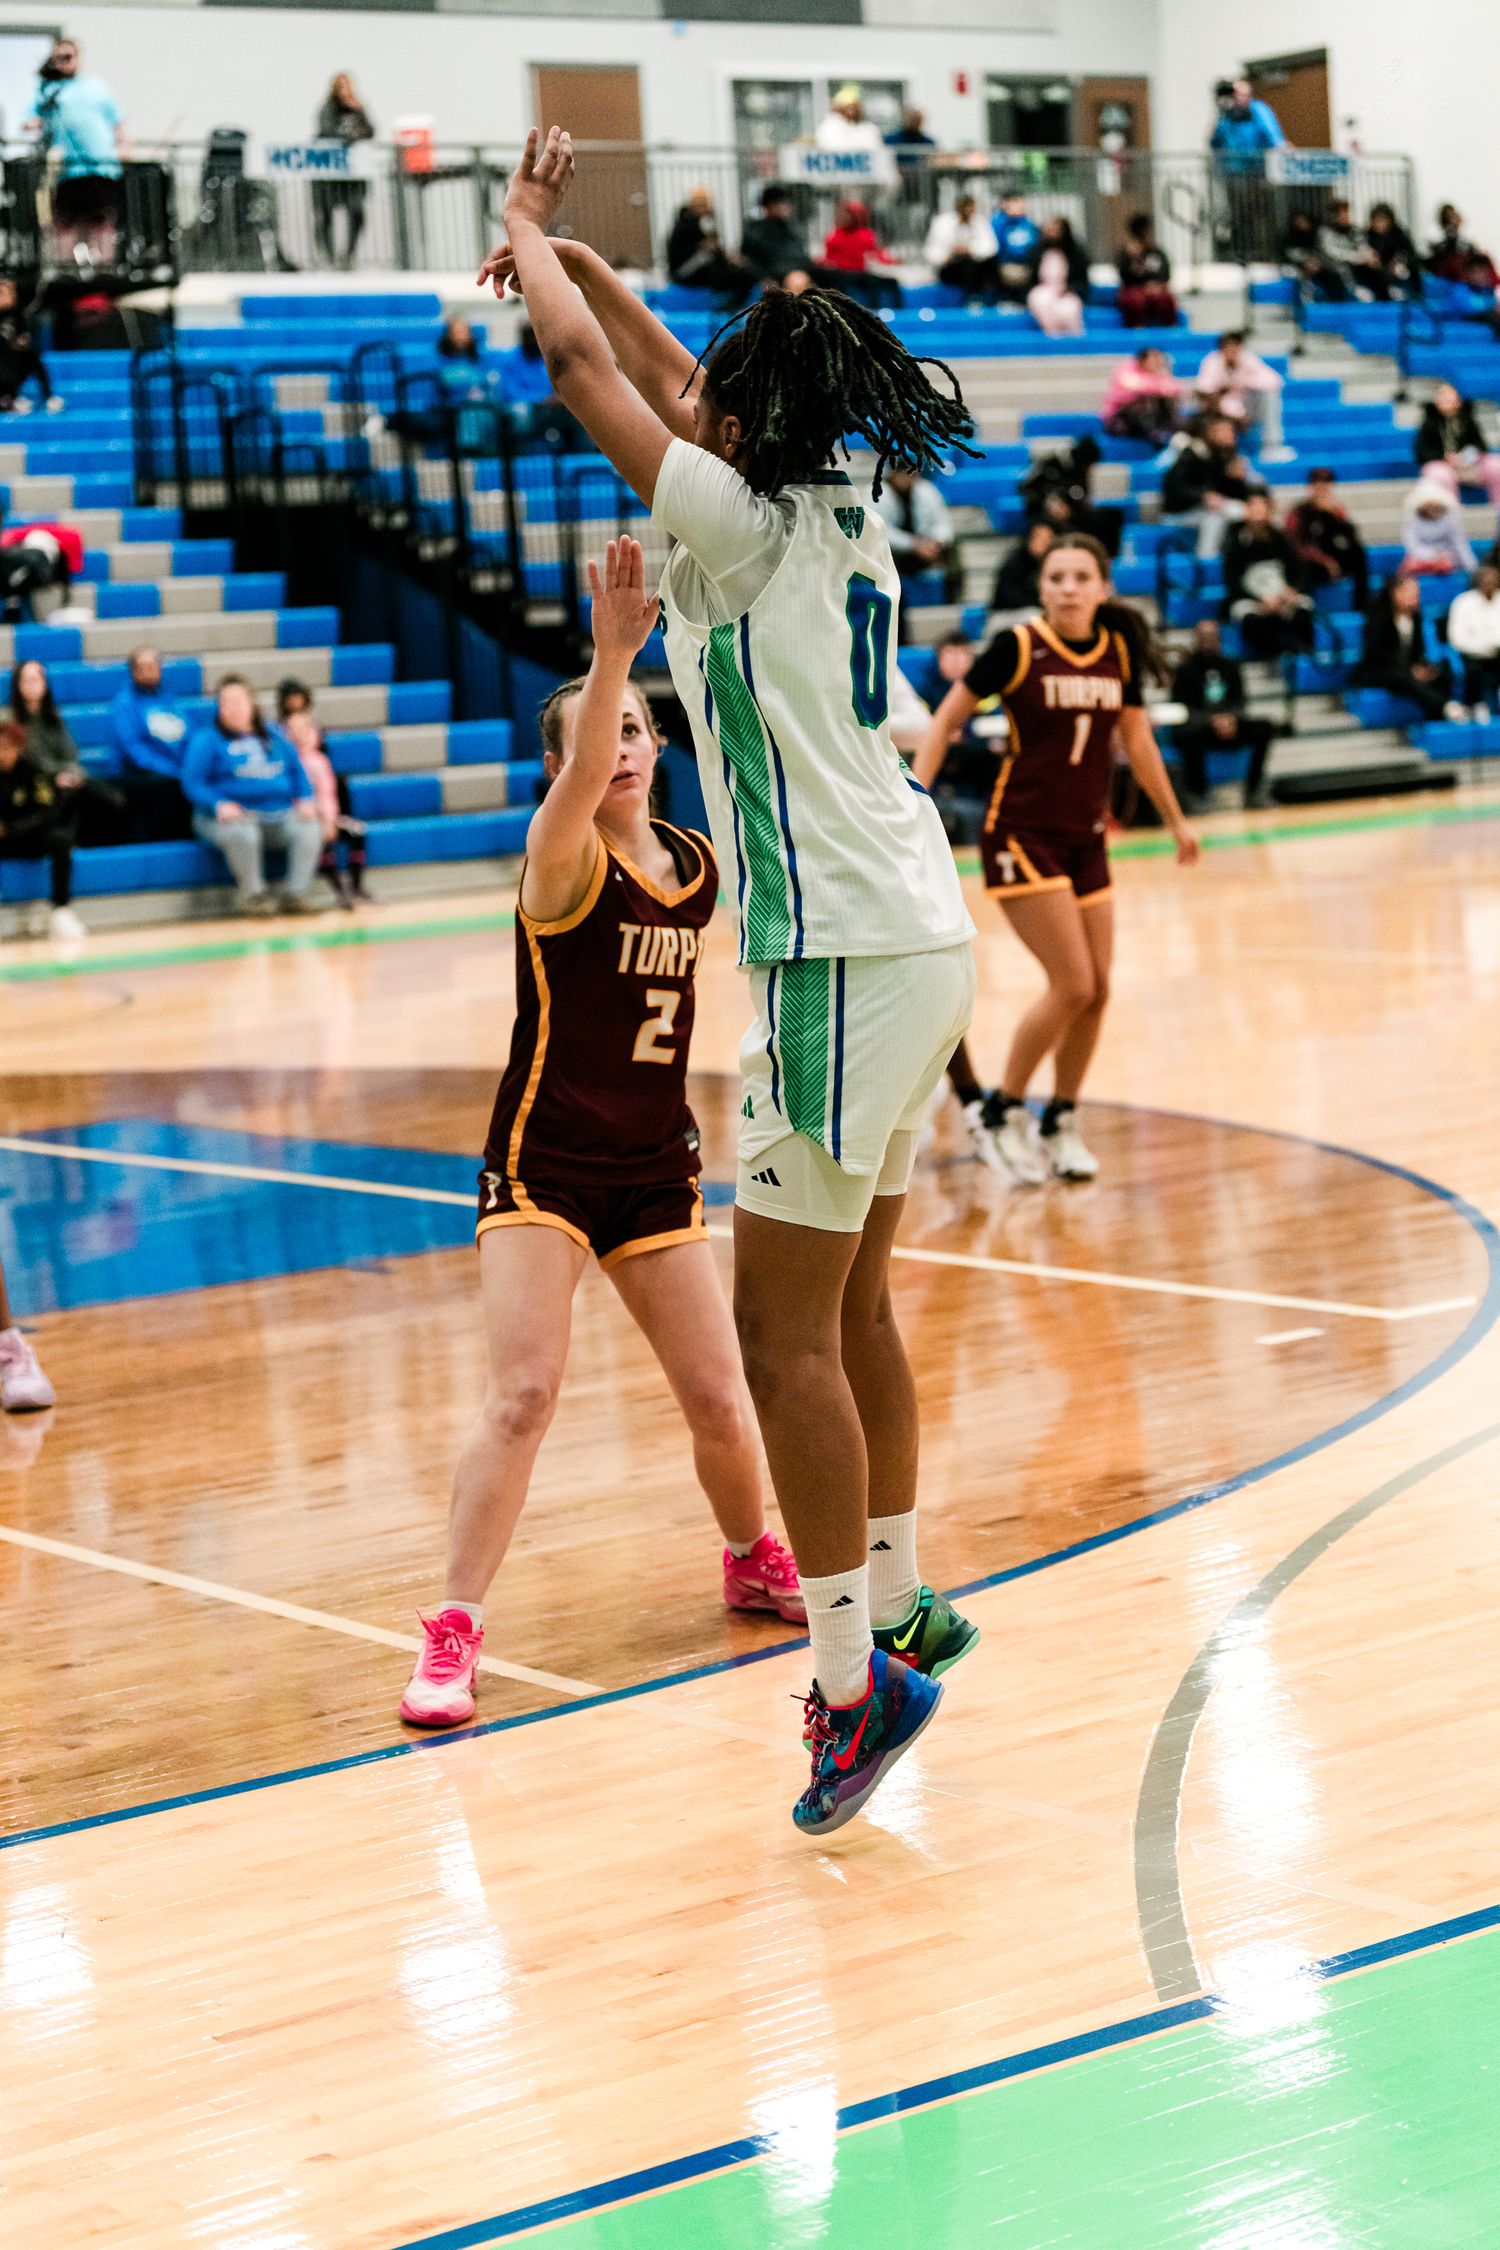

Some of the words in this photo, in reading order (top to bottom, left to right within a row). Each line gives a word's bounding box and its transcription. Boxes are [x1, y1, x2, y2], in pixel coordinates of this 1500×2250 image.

[833, 506, 865, 539] W
[845, 571, 892, 730] 0
[1041, 675, 1123, 710] TURPIN
[1069, 713, 1092, 765] 1
[632, 988, 681, 1064] 2
